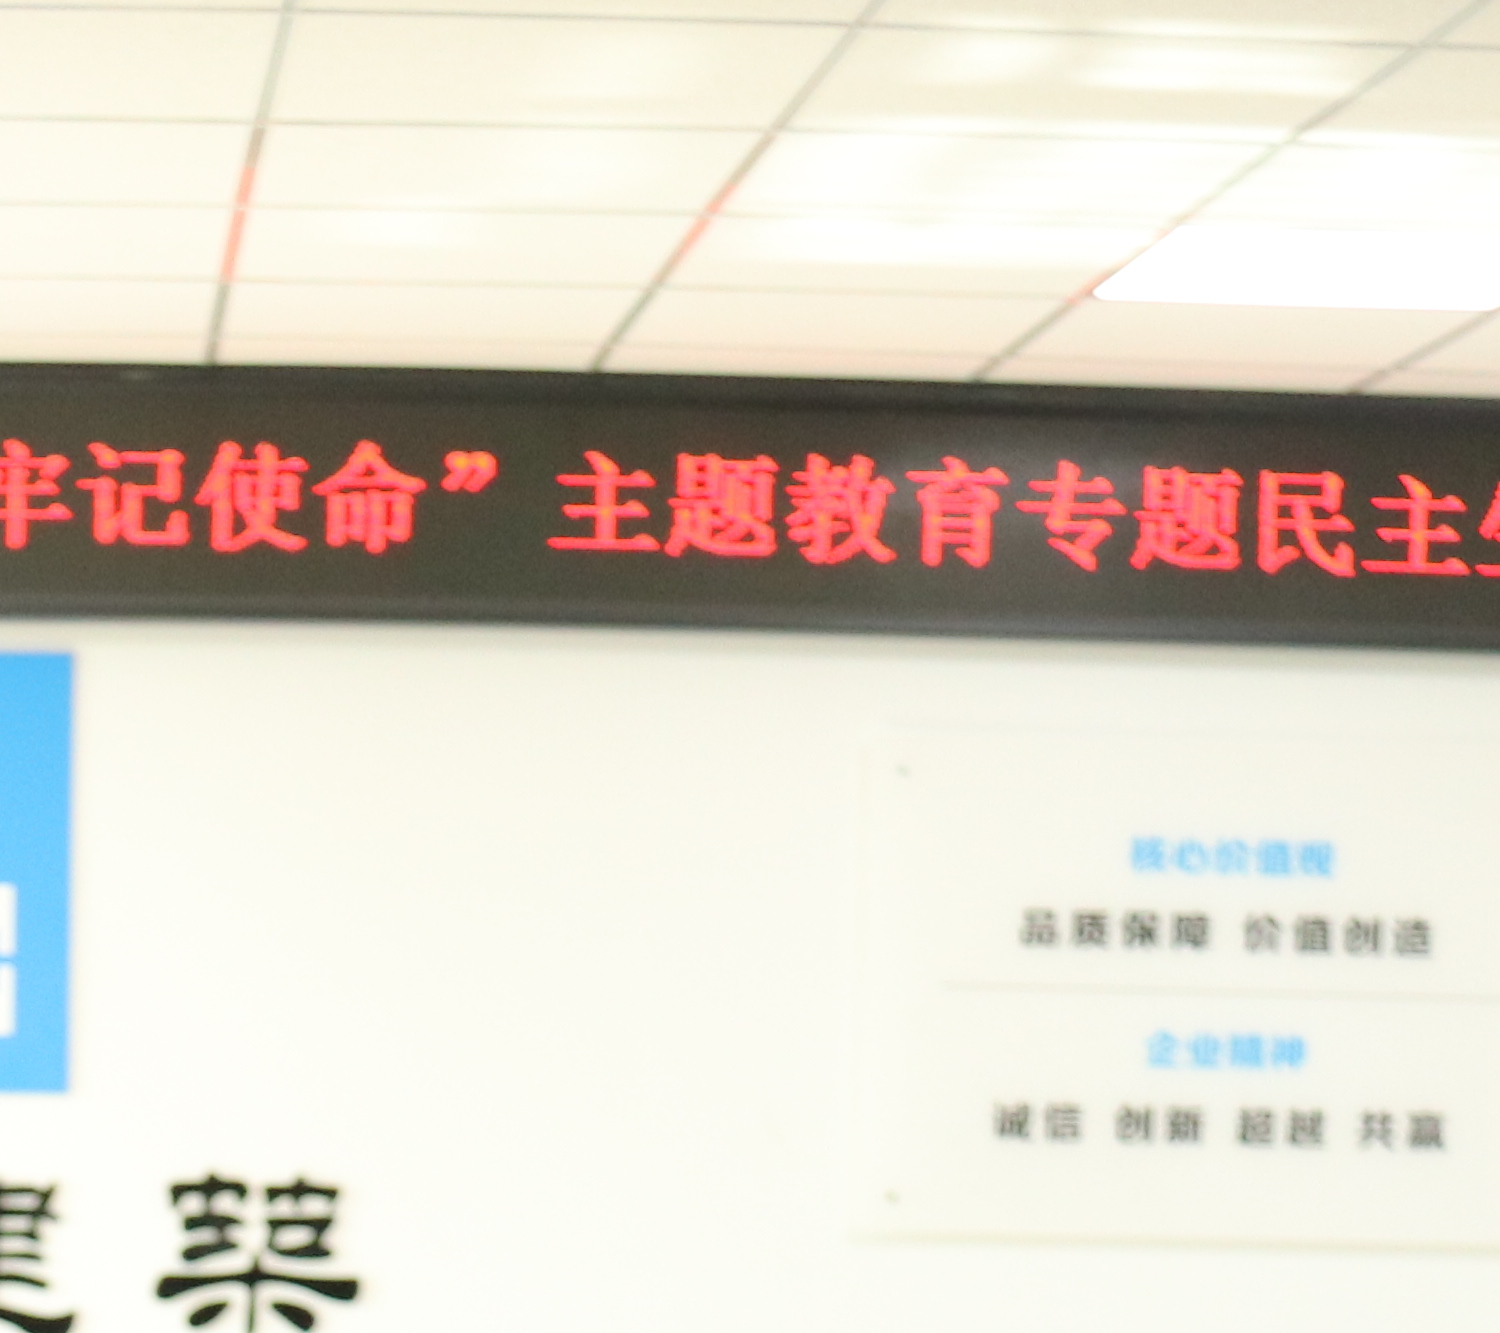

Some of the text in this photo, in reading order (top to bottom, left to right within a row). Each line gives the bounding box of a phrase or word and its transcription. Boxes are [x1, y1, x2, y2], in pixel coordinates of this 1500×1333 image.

[1131, 837, 1335, 878] 核心价值观
[1021, 909, 1432, 957] 品质保障 价值创造
[1148, 1030, 1308, 1071] 企业精神
[994, 1103, 1445, 1151] 诚信 创新 超越 共赢
